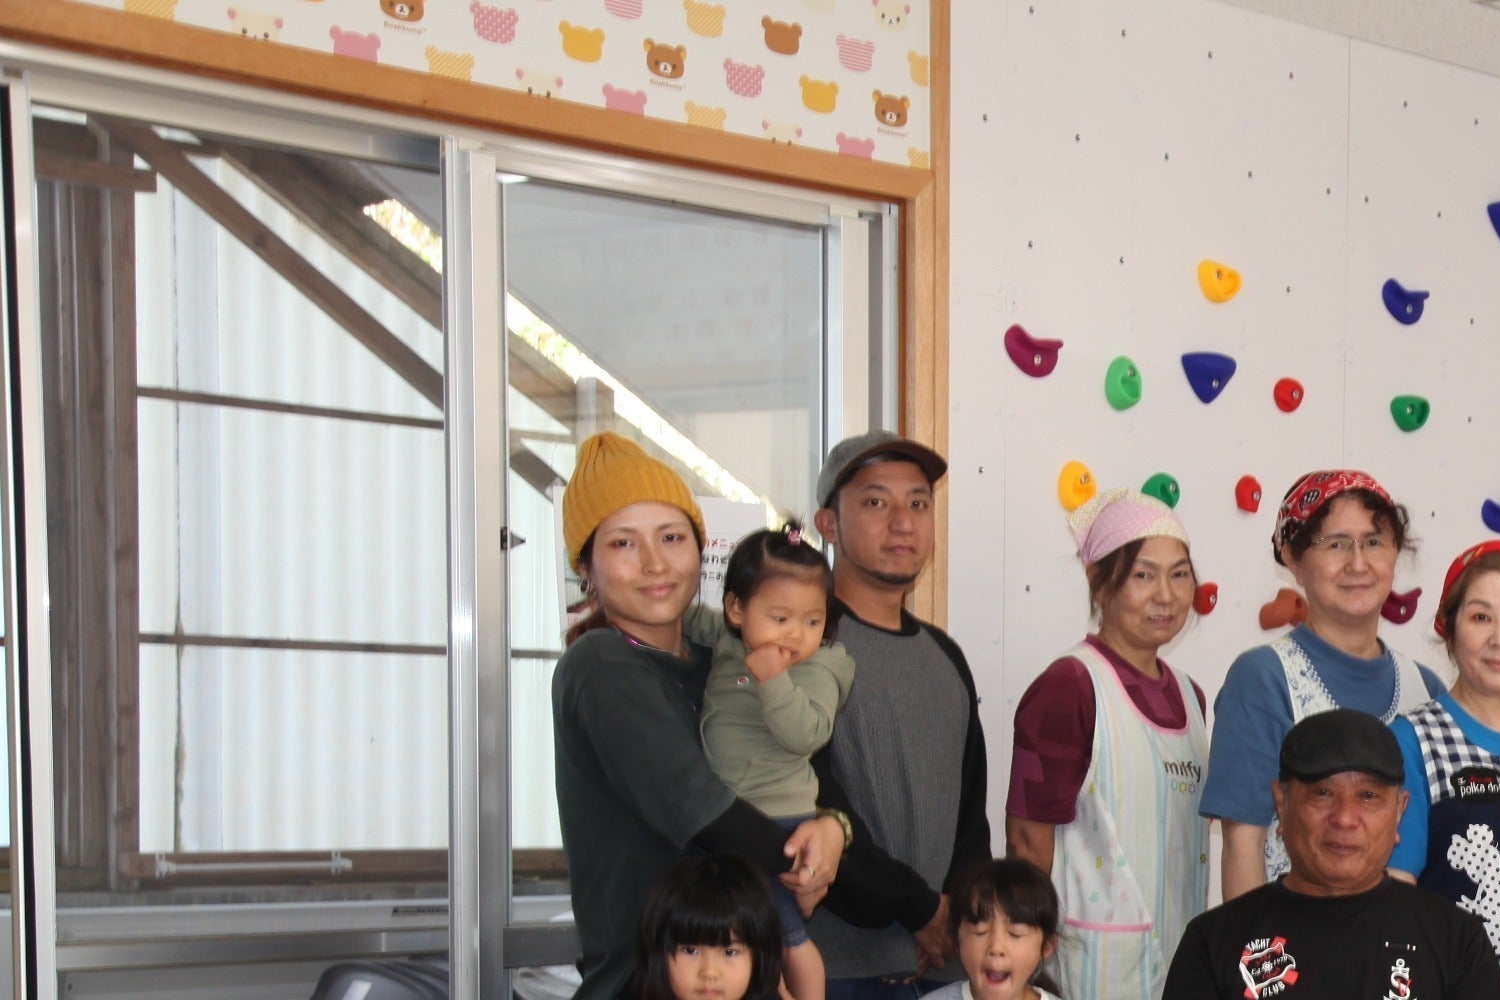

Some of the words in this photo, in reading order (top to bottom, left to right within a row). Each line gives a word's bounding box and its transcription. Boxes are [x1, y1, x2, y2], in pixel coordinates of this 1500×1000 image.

[1460, 781, 1486, 798] polka
[1245, 938, 1270, 952] YACHT
[1262, 980, 1286, 999] CLUB
